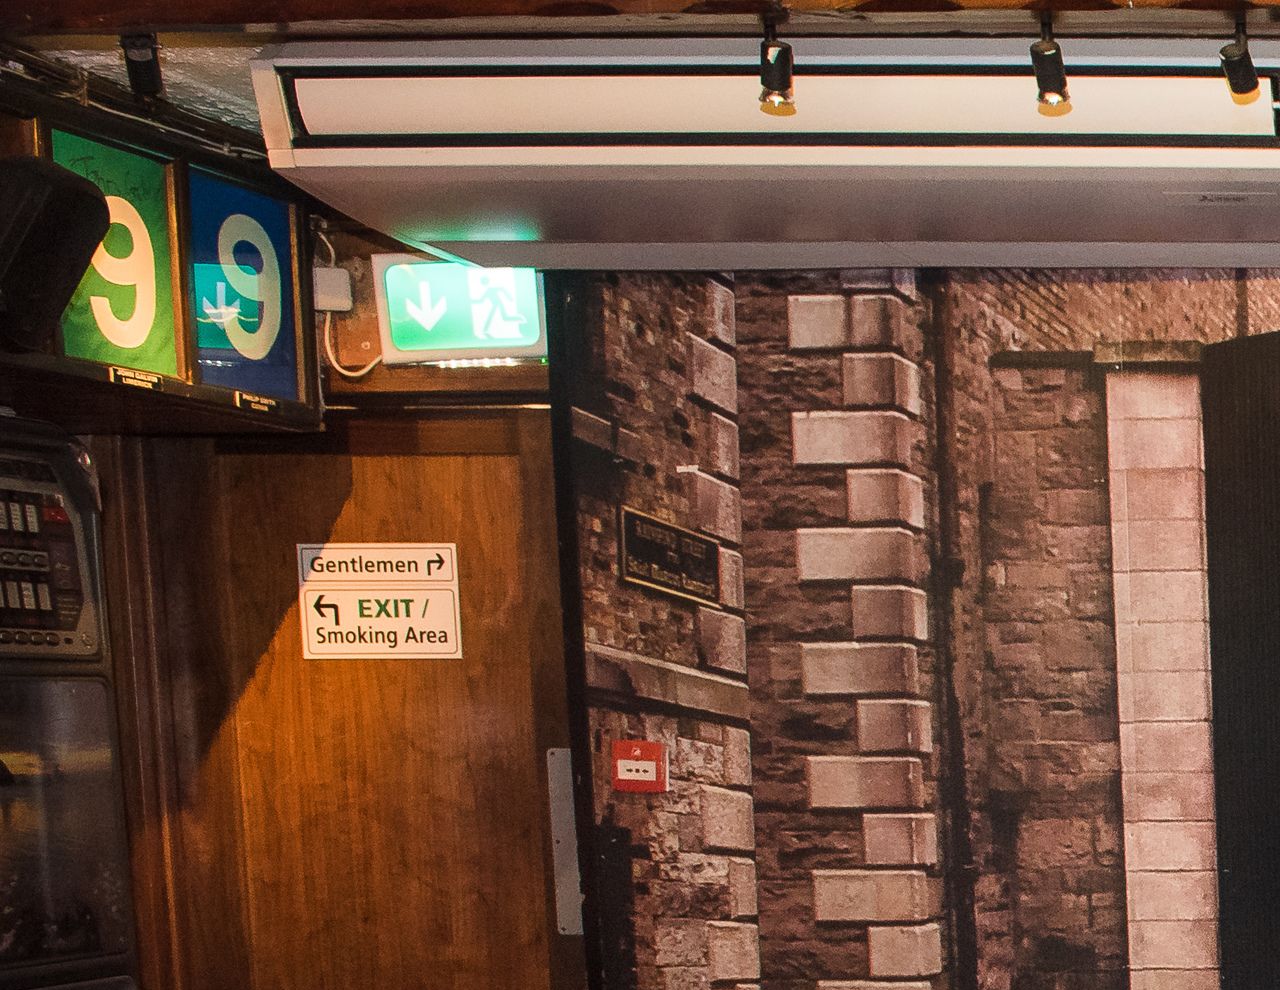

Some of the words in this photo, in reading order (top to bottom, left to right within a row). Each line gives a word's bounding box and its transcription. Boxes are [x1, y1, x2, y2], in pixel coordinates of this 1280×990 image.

[90, 195, 156, 349] 9
[218, 213, 281, 361] 9
[310, 555, 419, 573] Gentlemen
[358, 598, 415, 618] EXIT
[421, 598, 430, 619] /
[316, 626, 398, 649] Smoking
[404, 626, 448, 644] Area
